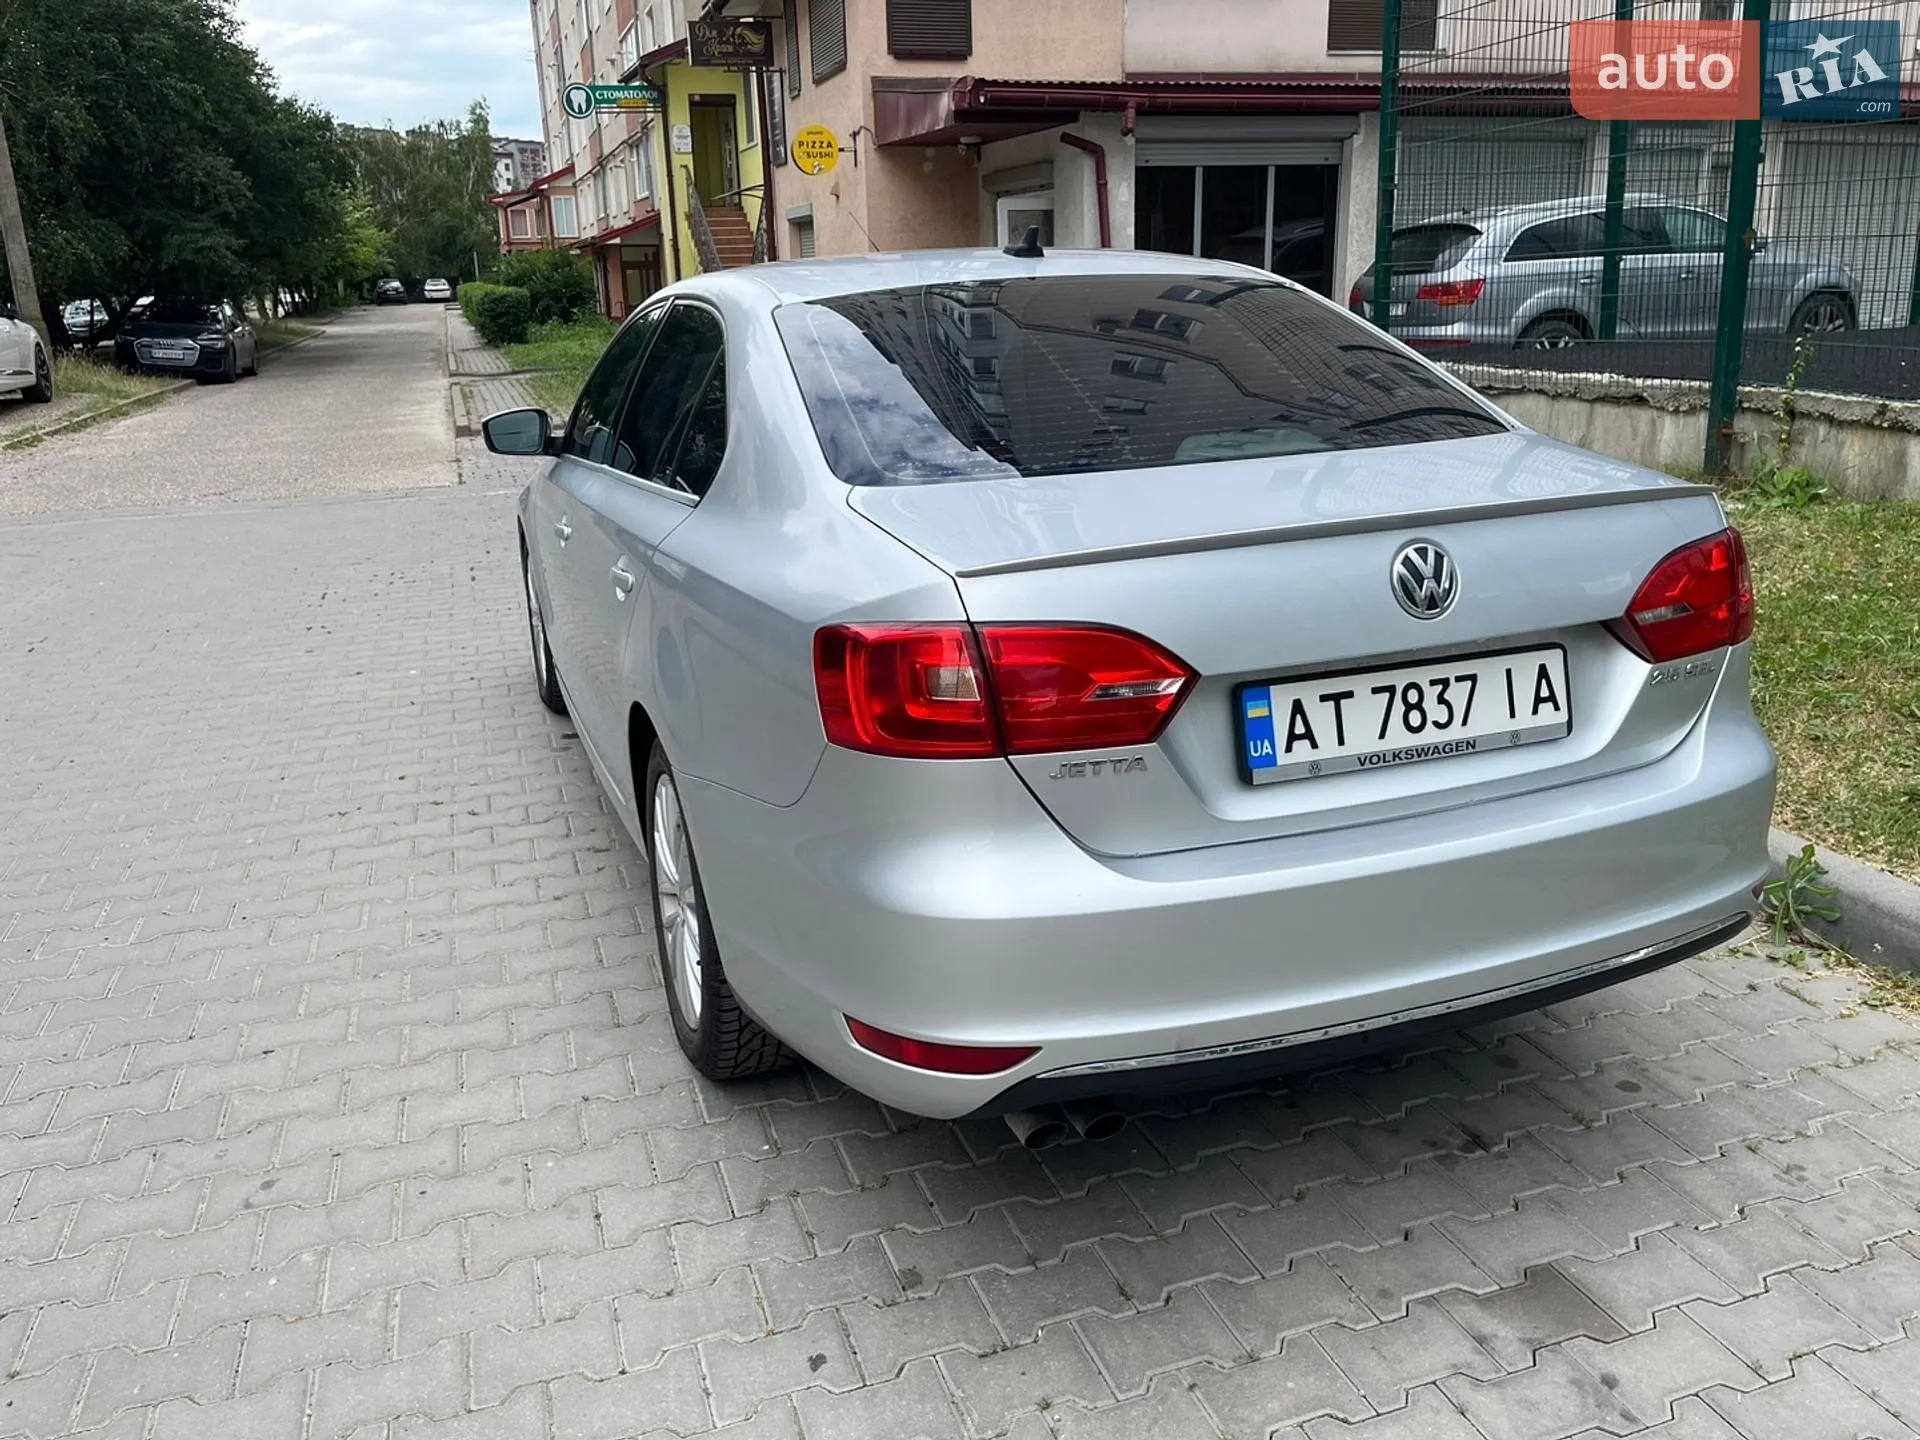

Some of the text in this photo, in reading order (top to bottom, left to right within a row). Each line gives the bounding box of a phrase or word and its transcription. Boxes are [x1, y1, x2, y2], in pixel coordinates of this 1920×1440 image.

[798, 140, 833, 149] PIZZA
[806, 150, 834, 159] SUSHI
[1284, 663, 1560, 753] AT 7837 IA
[1250, 739, 1273, 757] UA
[1357, 739, 1477, 767] VOLKSWAGEN
[1049, 755, 1148, 779] JETTA
